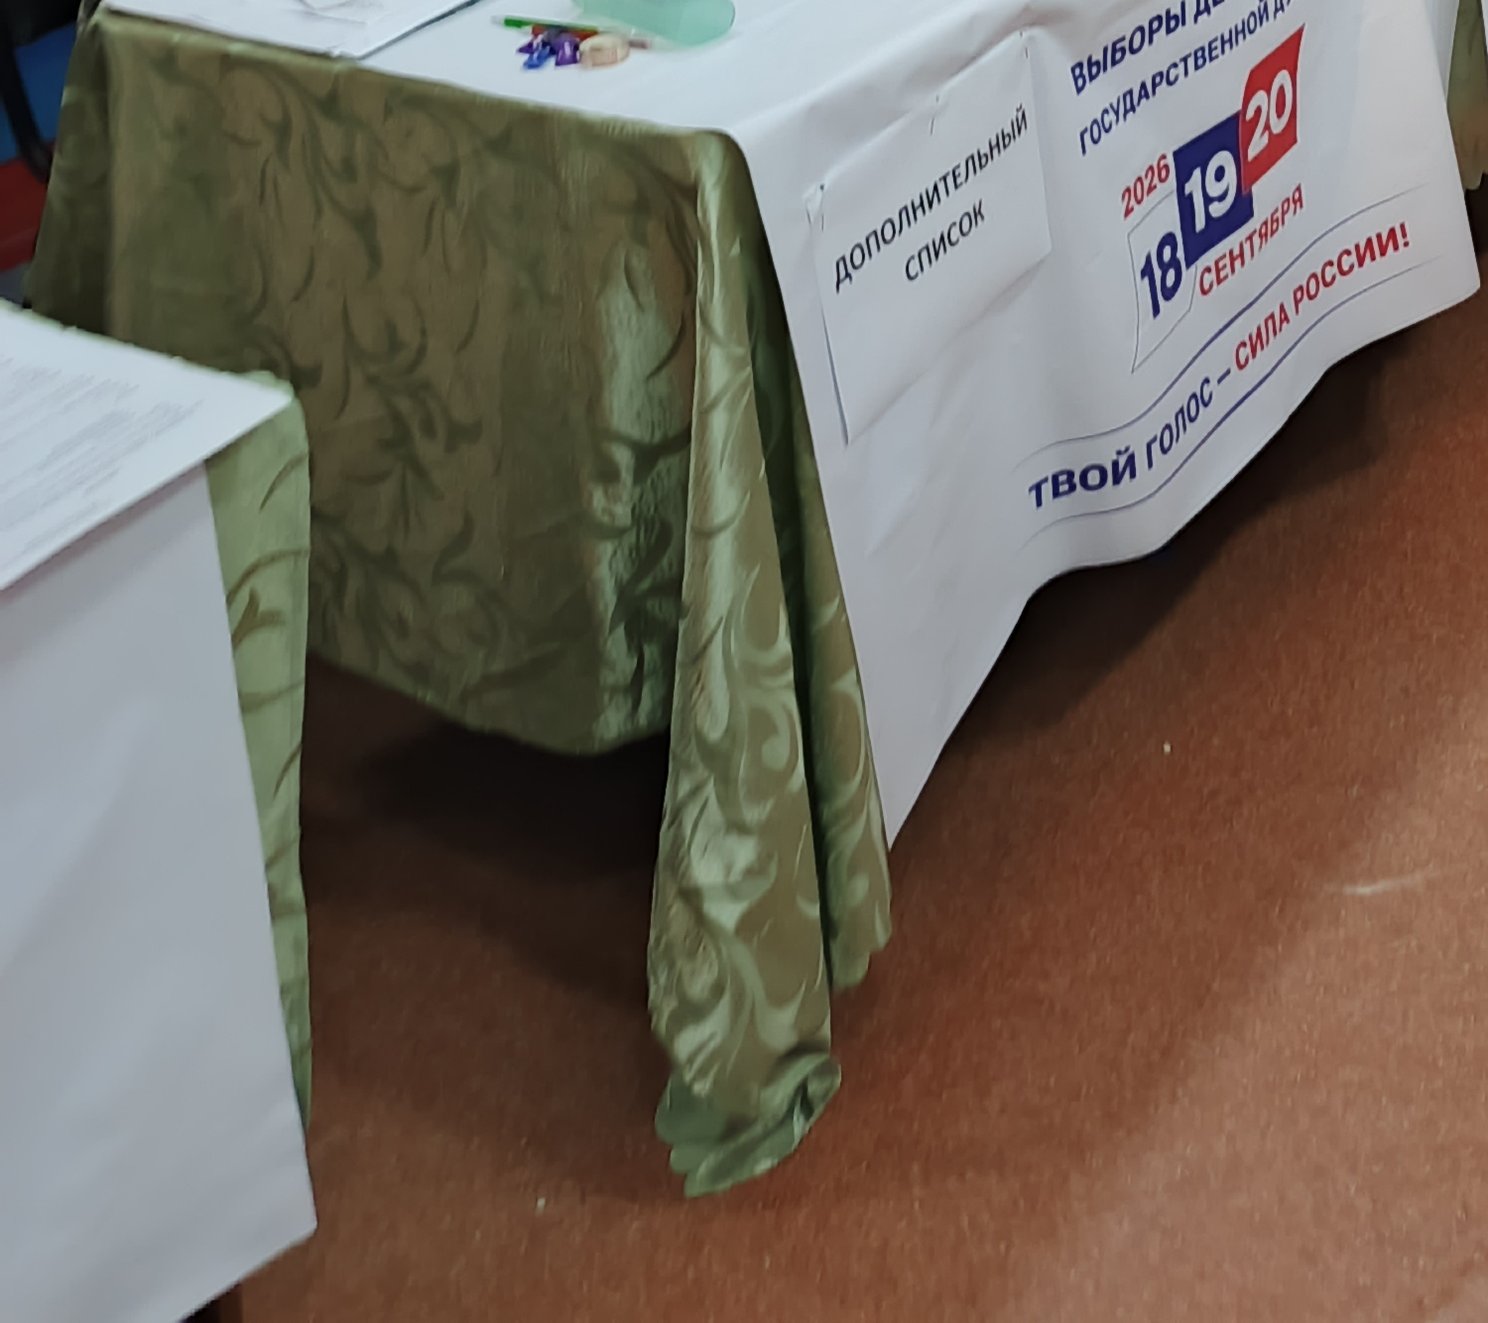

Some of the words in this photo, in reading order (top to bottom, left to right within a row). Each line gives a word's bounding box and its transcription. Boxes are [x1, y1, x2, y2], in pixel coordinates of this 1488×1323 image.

[1244, 68, 1295, 162] 20
[834, 106, 1029, 293] ДОПОЛНИТЕЛЬНЫЙ
[1120, 153, 1170, 219] 2026
[1184, 149, 1238, 233] 19
[903, 199, 986, 282] СПИСОК
[1139, 231, 1183, 320] 18
[1197, 182, 1304, 297] СЕНТЯБРЯ
[1026, 448, 1138, 509] ТВОЙ
[1145, 375, 1213, 470] ГОЛОС
[1234, 300, 1291, 373] СИЛА
[1291, 221, 1411, 317] РОССИИ!
